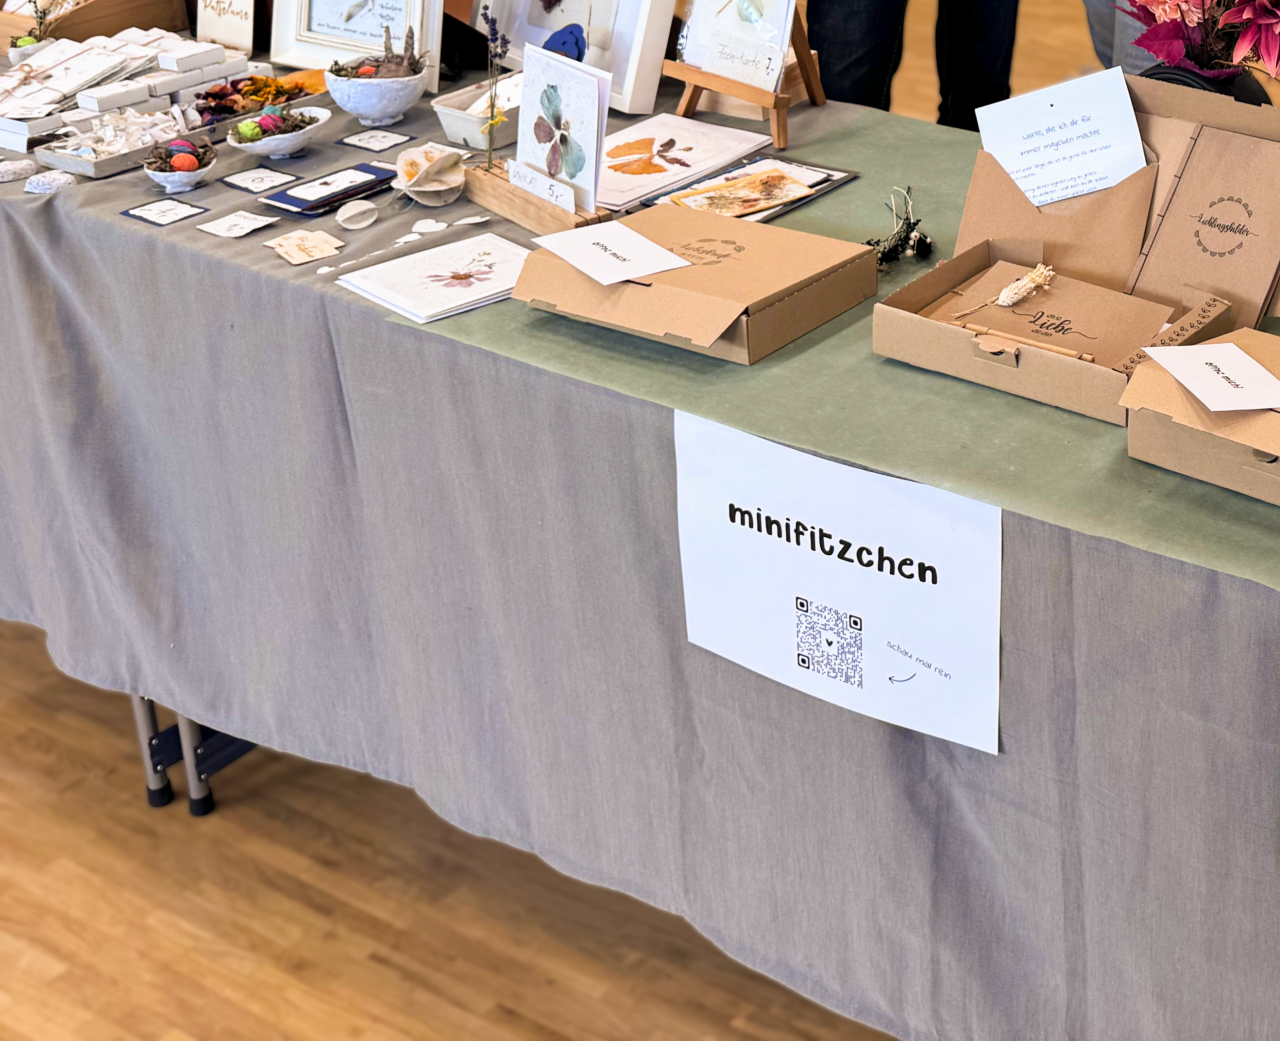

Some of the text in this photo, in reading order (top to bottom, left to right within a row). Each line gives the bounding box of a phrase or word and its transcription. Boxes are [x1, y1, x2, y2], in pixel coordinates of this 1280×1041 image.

[1045, 125, 1057, 134] die
[1058, 122, 1068, 130] ich
[1192, 213, 1256, 236] Lieblingsbilder
[1018, 310, 1088, 338] Liebe
[728, 502, 938, 585] minifitzchen
[887, 641, 951, 680] schau mal rein
